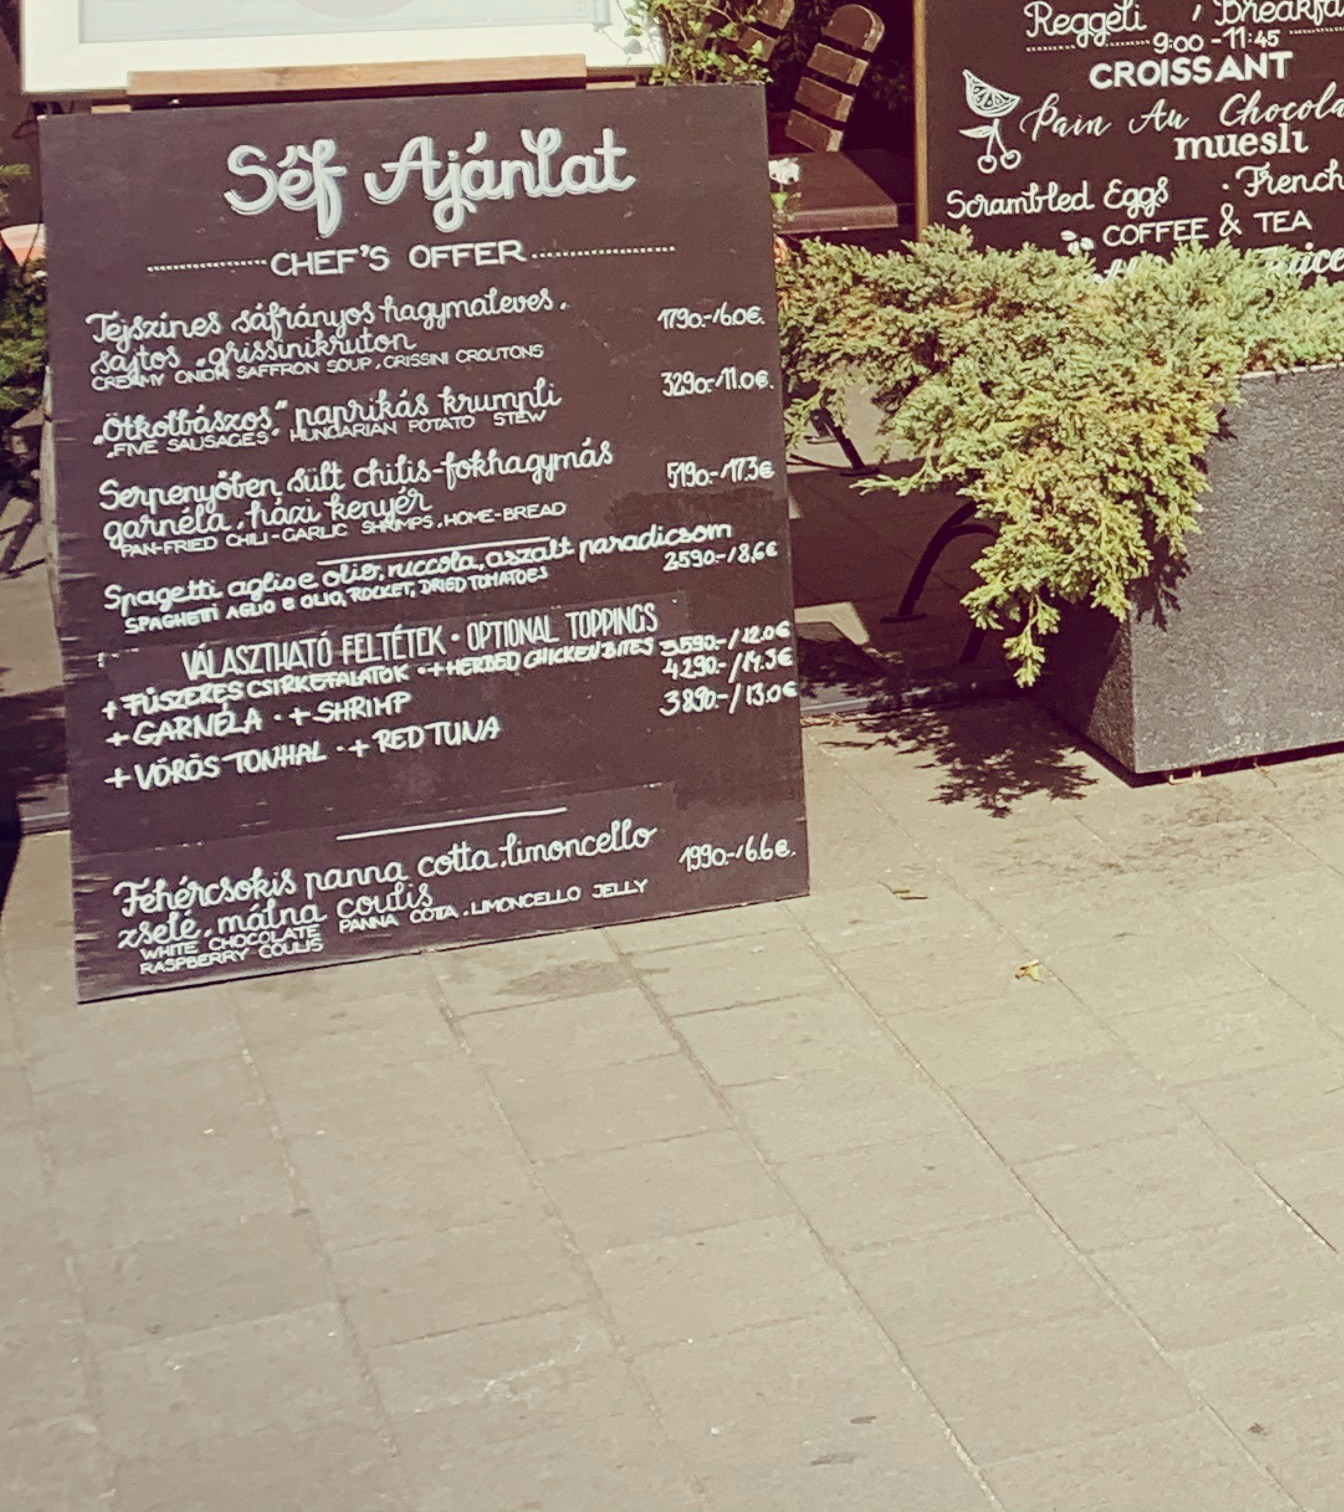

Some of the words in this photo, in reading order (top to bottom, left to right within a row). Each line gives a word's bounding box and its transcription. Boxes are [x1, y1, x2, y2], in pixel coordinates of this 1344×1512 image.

[1089, 51, 1294, 89] CROISSANT
[1020, 93, 1111, 143] Pain
[1128, 97, 1191, 134] Au
[1175, 122, 1309, 162] muesli
[224, 135, 348, 238] Séf
[364, 127, 636, 231] Ajánlat
[947, 179, 1095, 220] Scrambled
[1104, 178, 1169, 219] Eggs
[1102, 218, 1208, 246] COFFEE
[1219, 203, 1242, 237] &
[1253, 210, 1313, 234] TEA
[408, 239, 527, 268] OFFER
[85, 311, 223, 353] Tejszínes
[231, 301, 375, 340] sáfrányos
[236, 360, 320, 380] SAFFRON
[456, 344, 544, 364] CROUTONS
[409, 414, 476, 434] POTATO
[494, 409, 547, 427] STEW
[121, 536, 218, 559] PAN-FRIED
[181, 630, 332, 681] VÁLASZTHATÓ
[341, 624, 446, 665] FELTÉTEK
[466, 614, 558, 651] OPTIONAL
[565, 603, 659, 640] TOPPINGS
[221, 740, 328, 775] TONHAL
[371, 725, 424, 753] RED
[424, 717, 501, 747] TUNA
[304, 861, 409, 900] panna
[139, 941, 198, 961] WHITE
[208, 924, 321, 951] CHOCOLATE
[339, 914, 399, 934] PANNA
[592, 878, 648, 899] JELLY
